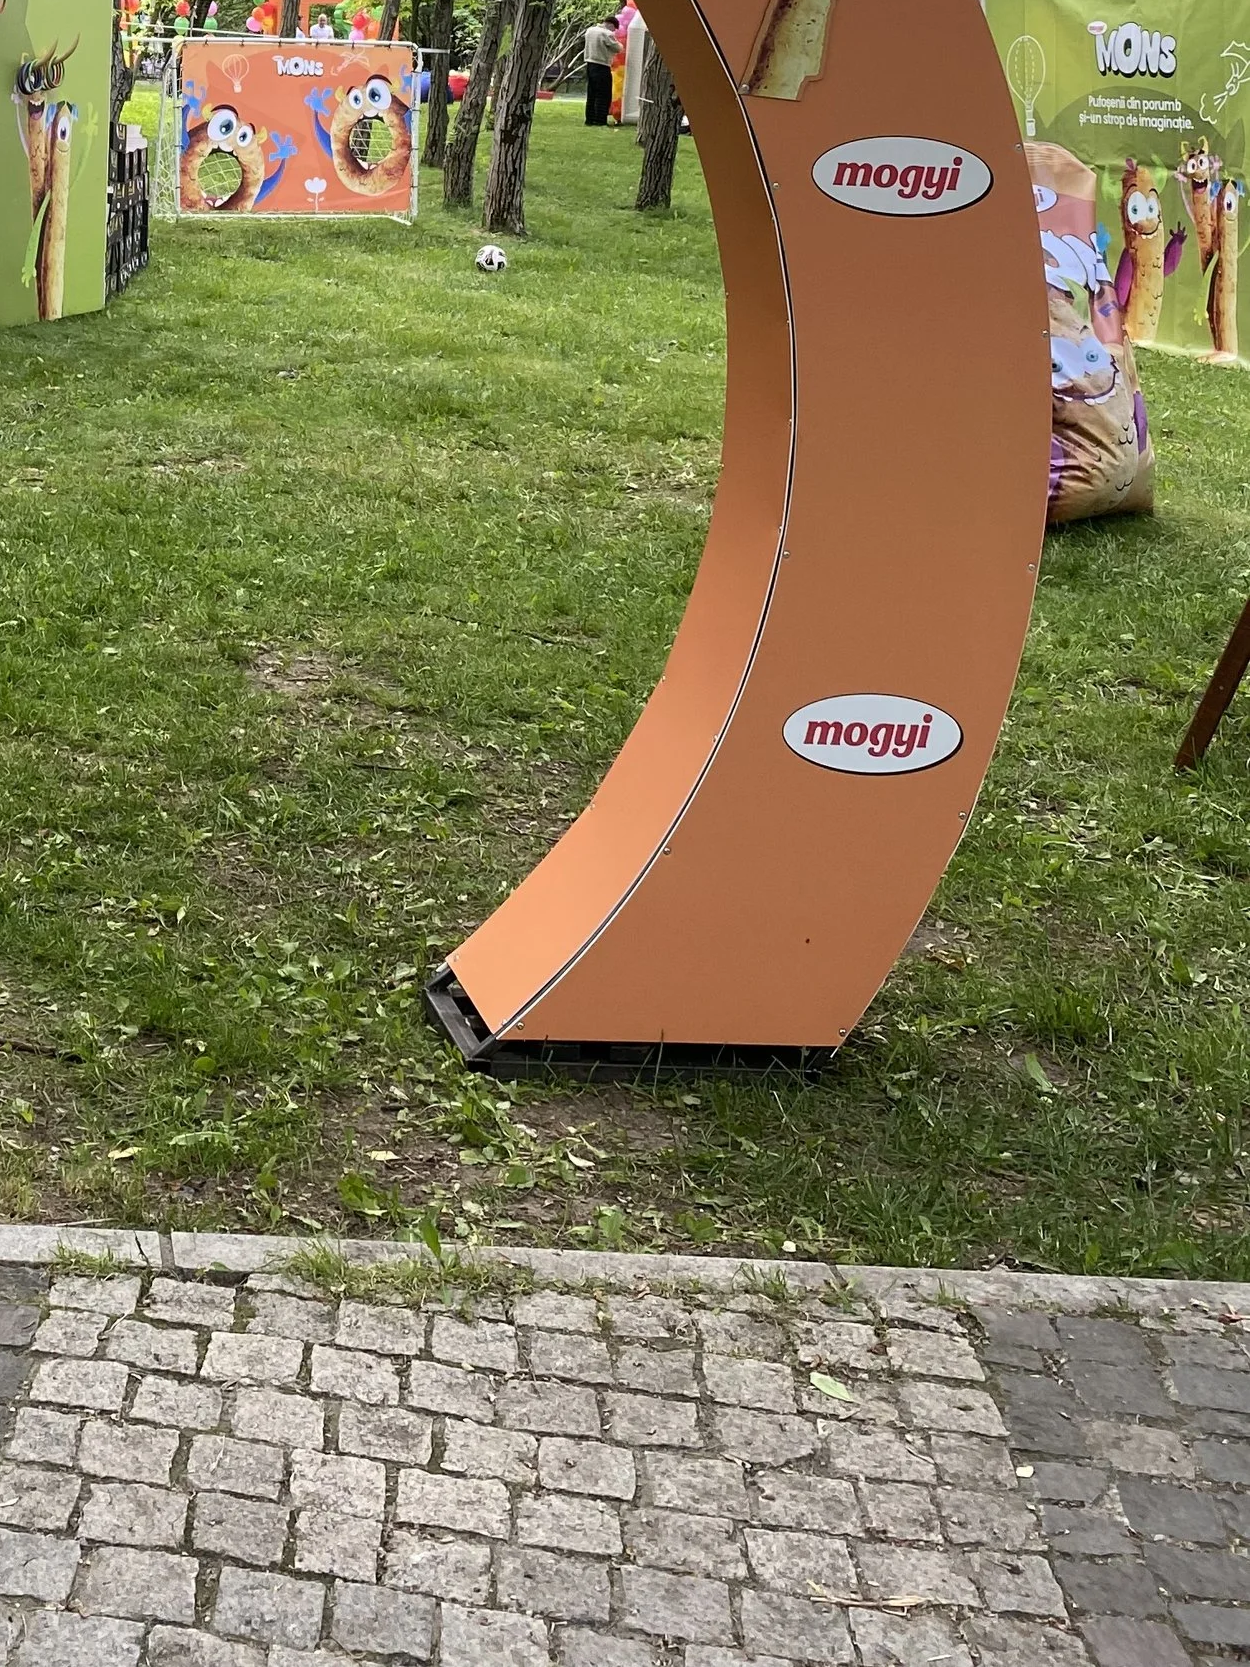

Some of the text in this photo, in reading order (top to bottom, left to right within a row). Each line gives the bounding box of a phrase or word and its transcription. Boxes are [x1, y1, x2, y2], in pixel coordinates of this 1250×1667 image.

[1095, 21, 1177, 78] MONS
[276, 56, 324, 77] MONS
[1102, 112, 1126, 130] strop
[1126, 113, 1139, 126] de
[1126, 96, 1141, 110] din
[1142, 98, 1182, 114] porumb
[832, 156, 963, 200] mogyi
[803, 713, 933, 758] mogyi
